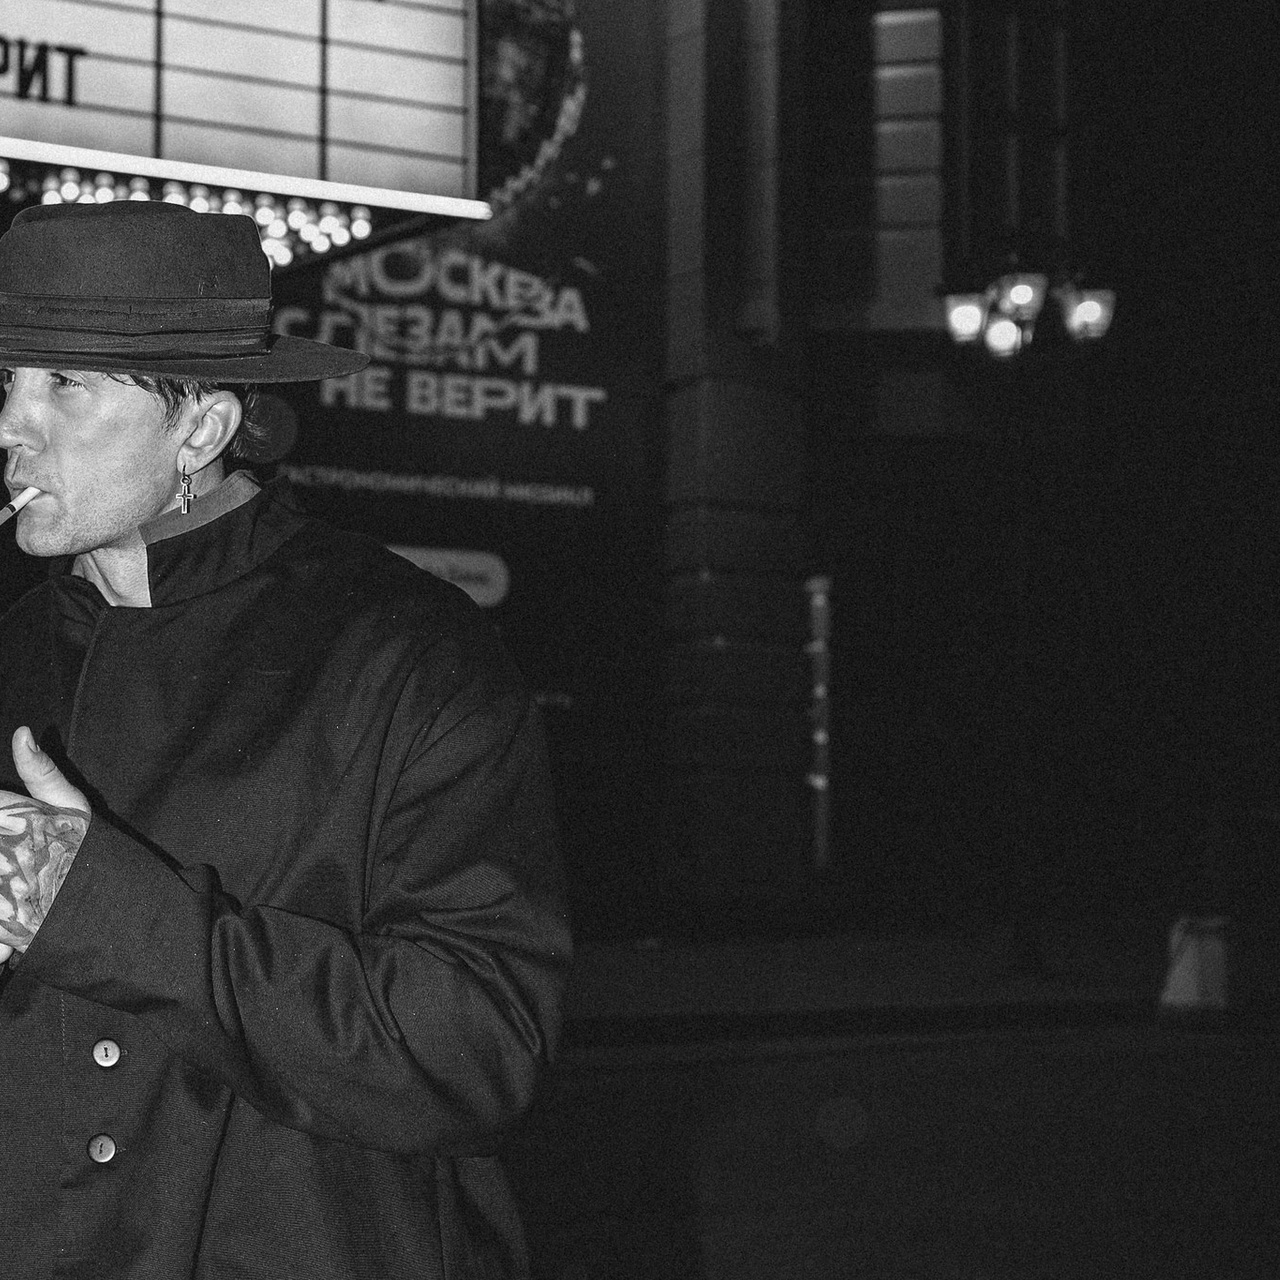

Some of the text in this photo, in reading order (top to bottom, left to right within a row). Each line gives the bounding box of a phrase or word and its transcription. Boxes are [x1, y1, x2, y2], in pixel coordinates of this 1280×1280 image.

[322, 237, 591, 333] МОСКВА
[320, 365, 607, 430] НЕ ВЕРИТ
